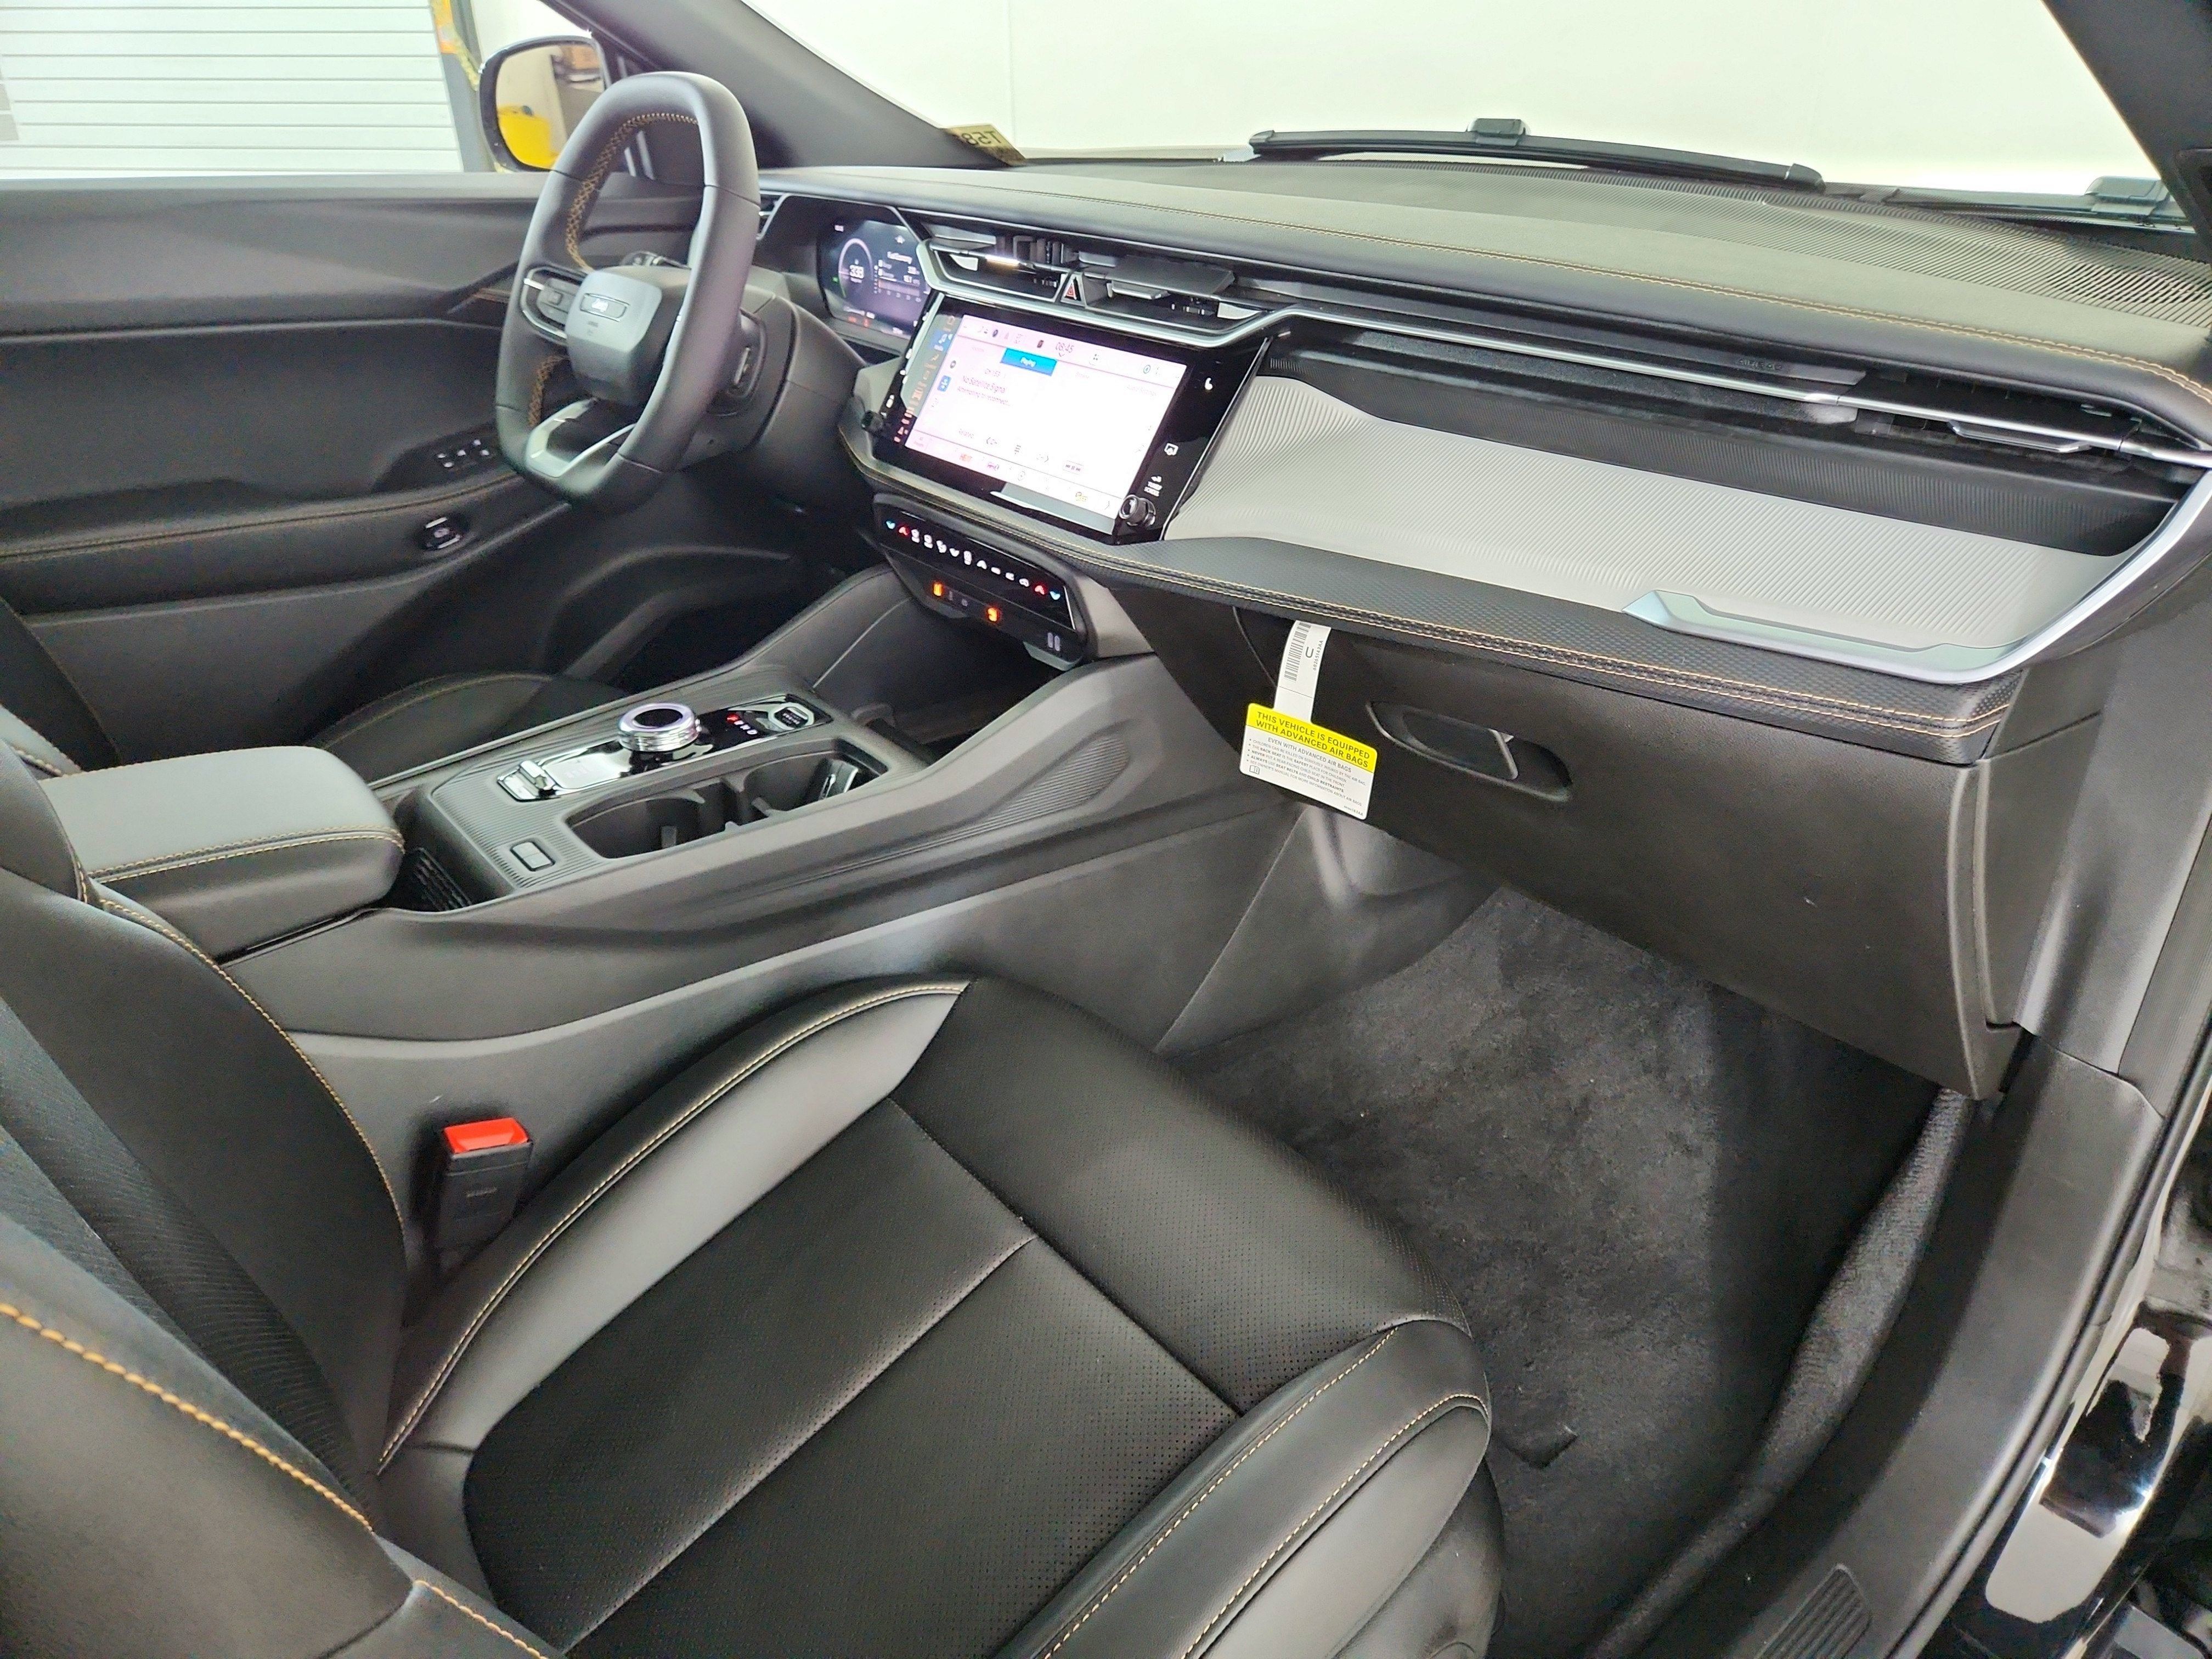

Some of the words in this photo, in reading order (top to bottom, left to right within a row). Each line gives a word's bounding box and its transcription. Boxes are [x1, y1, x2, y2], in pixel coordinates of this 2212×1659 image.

[1056, 342, 1074, 353] 08:45
[1306, 647, 1314, 658] U
[1257, 712, 1277, 724] THIS
[1279, 719, 1315, 737] VEHICLE
[1317, 732, 1325, 741] IS
[1328, 737, 1369, 759] EQUIPPED
[1256, 720, 1278, 733] WITH
[1280, 729, 1328, 750] ADVANCED
[1329, 747, 1344, 758] AIR
[1346, 753, 1369, 768] BAGS
[1251, 749, 1265, 757] NEVER
[1268, 737, 1282, 746] EVEN
[1283, 742, 1296, 751] WITH
[1297, 748, 1326, 762] ADVANCED
[1337, 763, 1351, 772] BAGS
[1251, 754, 1267, 764] ALWAYS
